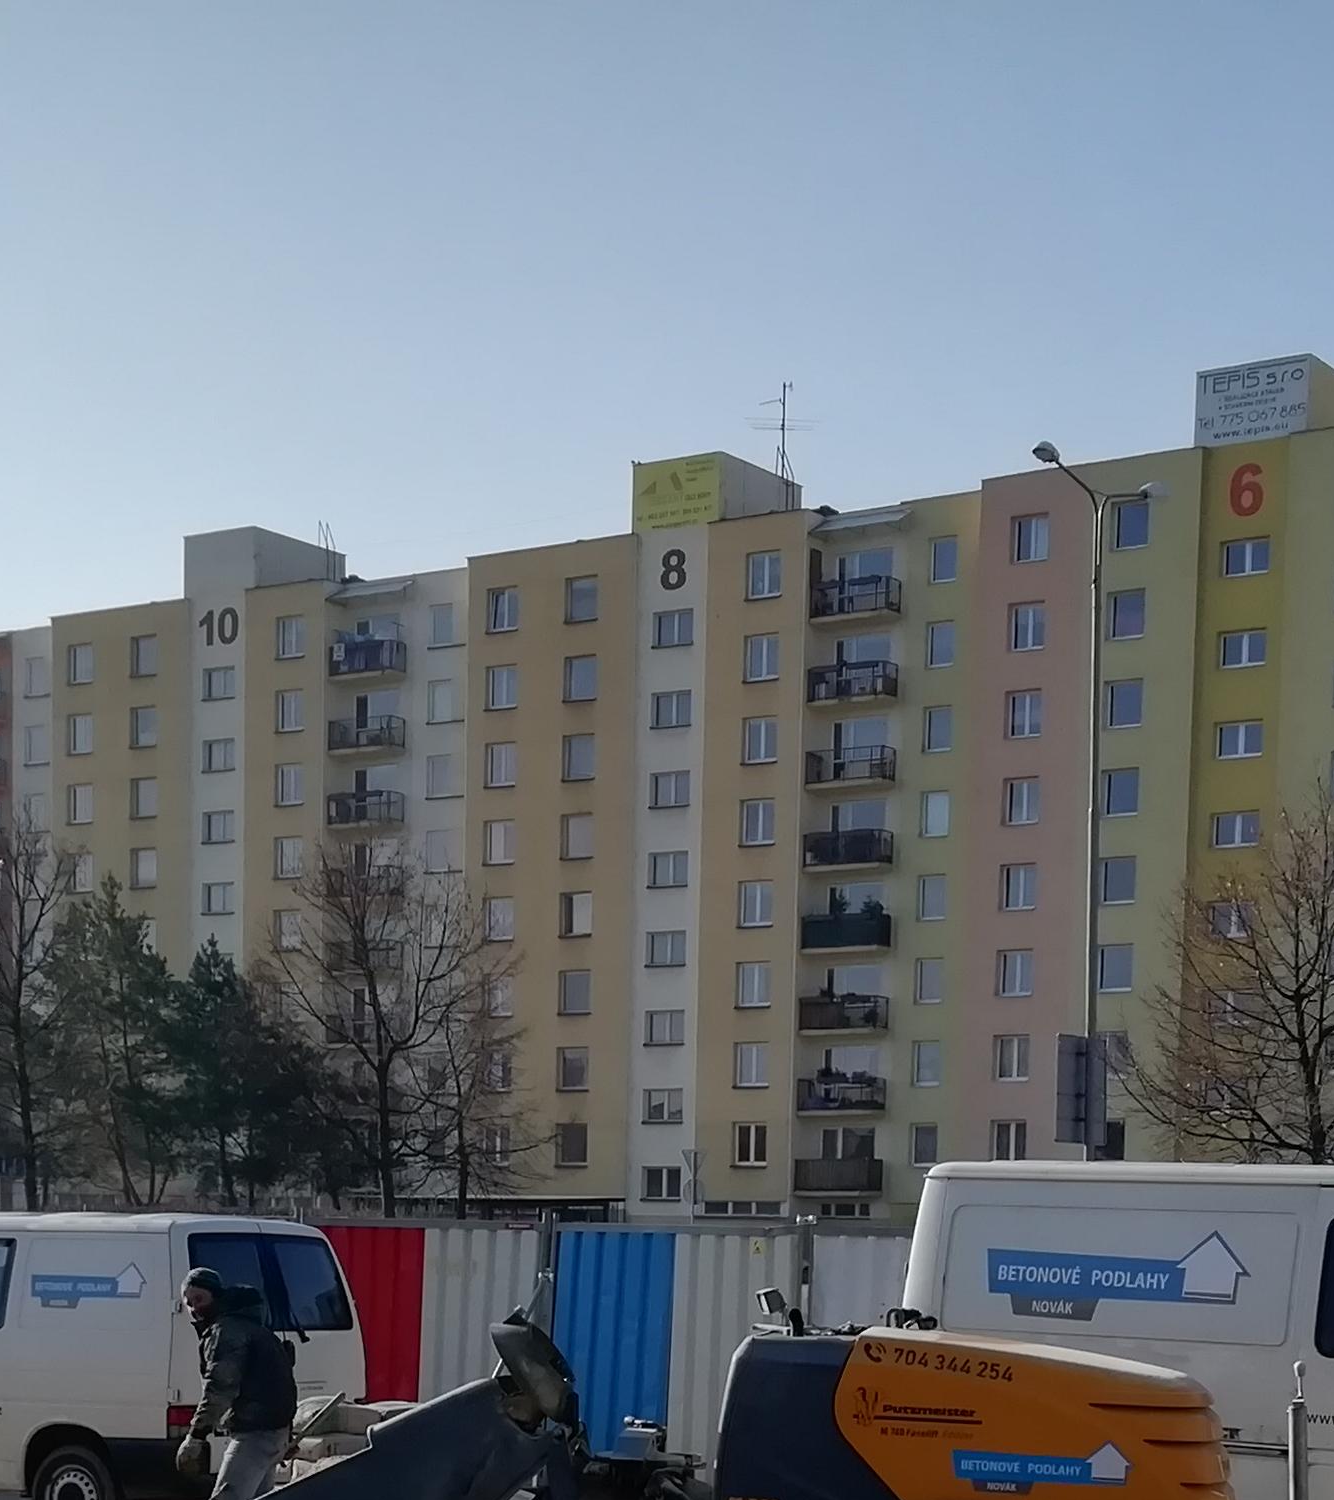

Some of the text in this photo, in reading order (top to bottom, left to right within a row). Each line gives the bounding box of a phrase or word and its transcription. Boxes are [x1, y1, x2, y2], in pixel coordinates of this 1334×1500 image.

[1220, 411, 1244, 426] 775
[1247, 408, 1277, 423] 067
[1230, 463, 1264, 517] 6
[660, 548, 687, 591] 8
[198, 607, 239, 647] 10
[997, 1263, 1169, 1290] BETONOVÉ PODLAHY
[1031, 1298, 1074, 1315] NOVÁK
[893, 1348, 1014, 1382] 704 344 254
[883, 1404, 976, 1418] Putzmeister
[1027, 1463, 1082, 1477] PODLAHY
